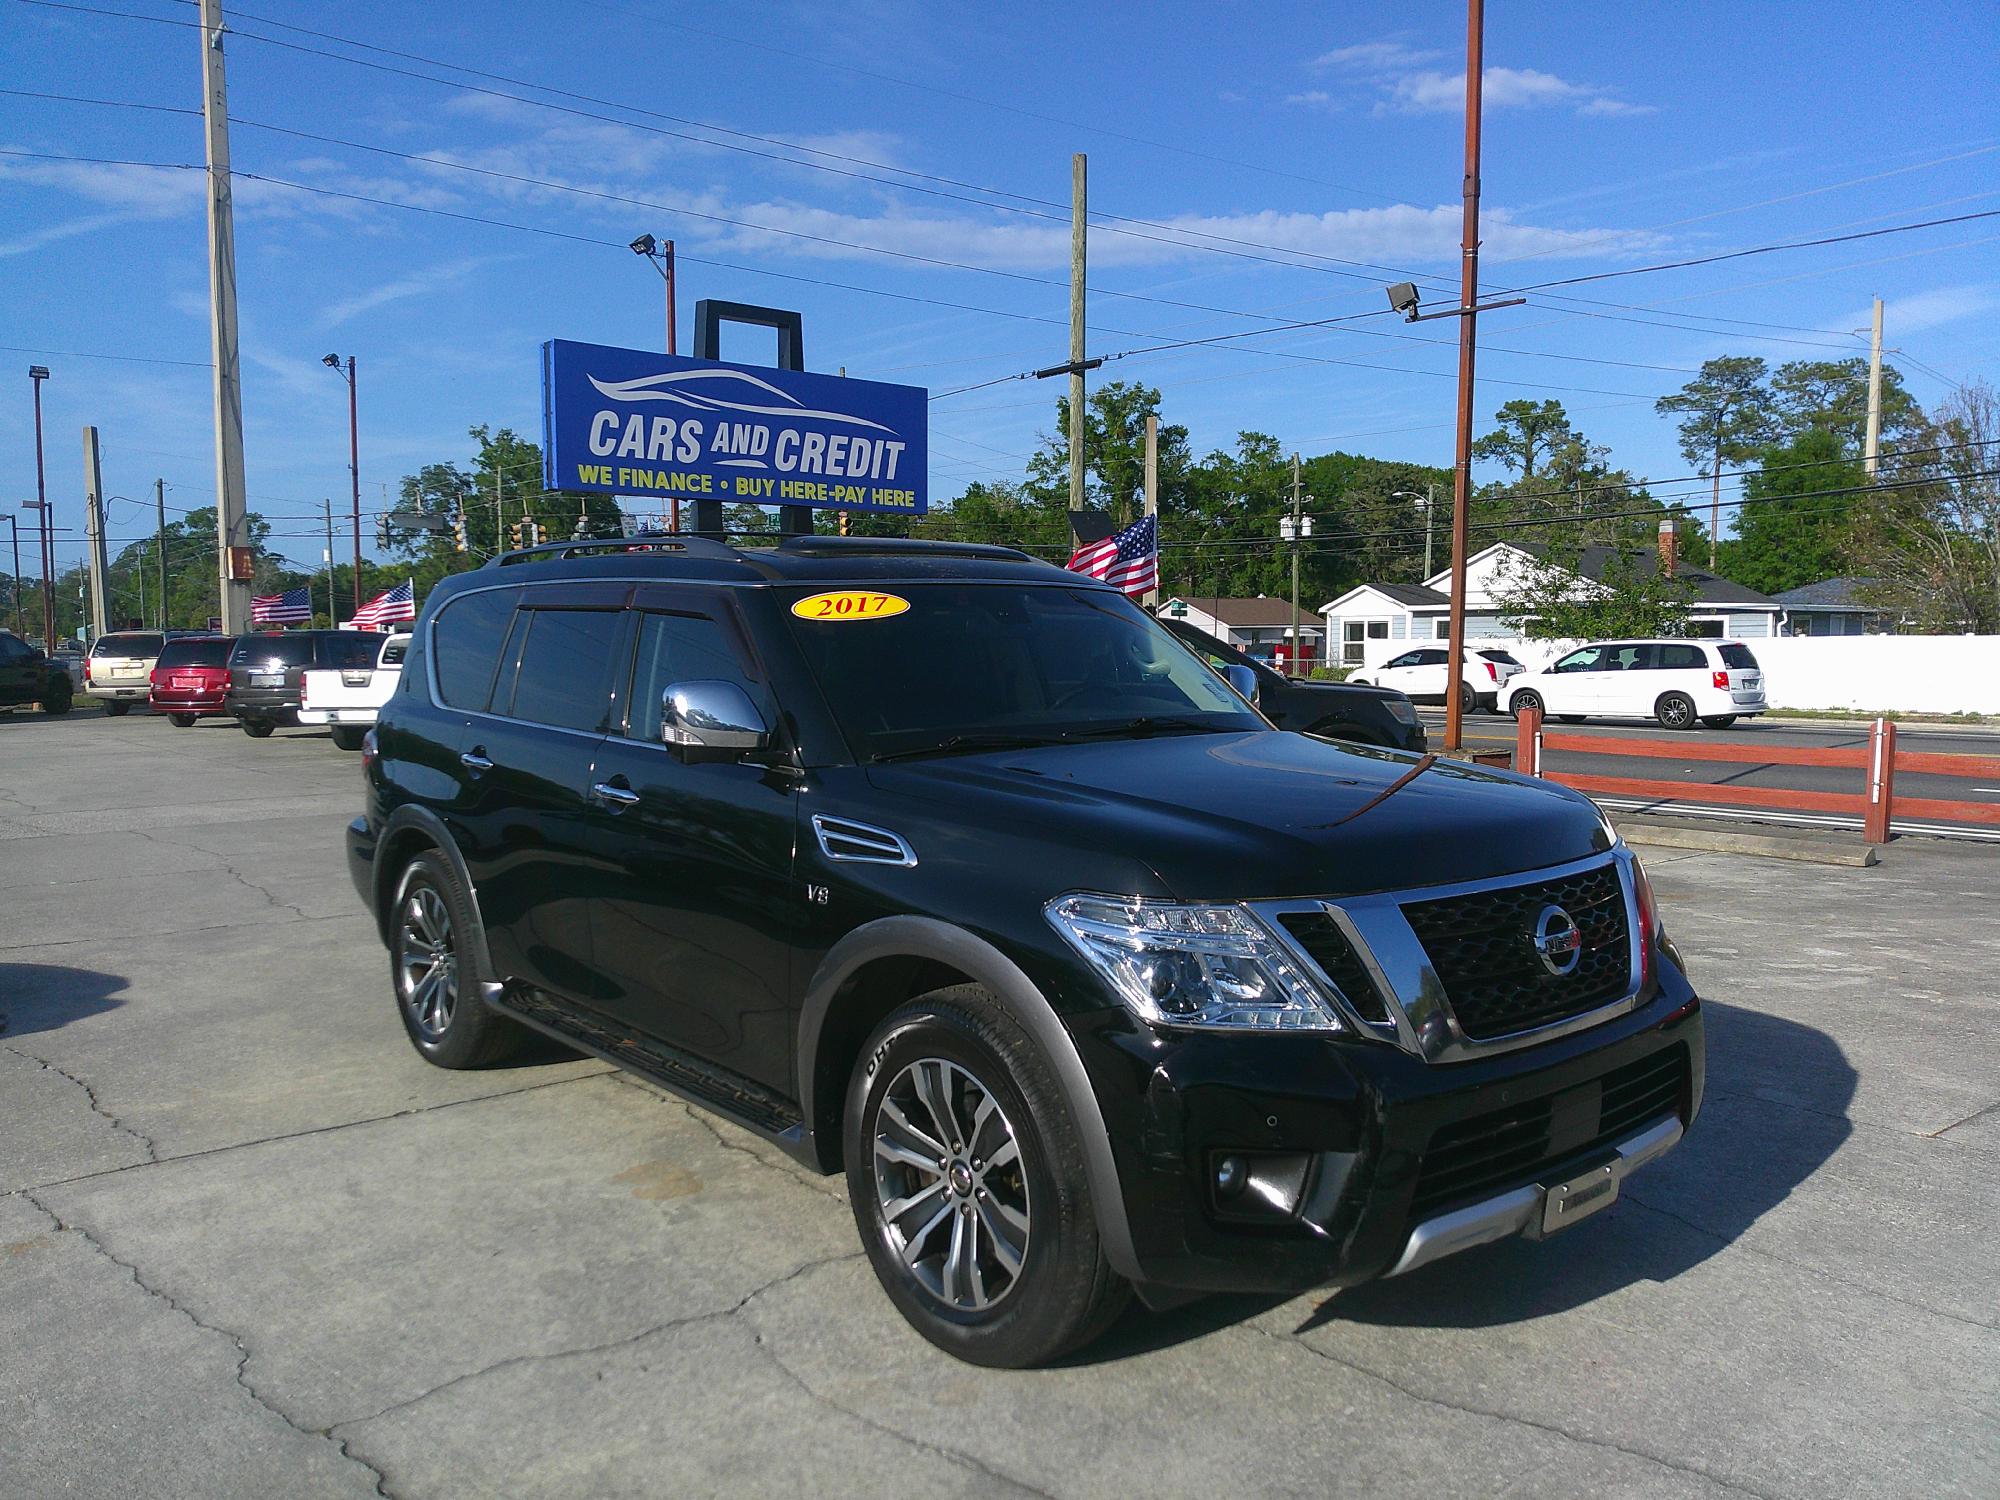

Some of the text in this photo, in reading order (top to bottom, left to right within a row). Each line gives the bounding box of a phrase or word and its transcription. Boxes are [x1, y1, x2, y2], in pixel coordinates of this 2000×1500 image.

[589, 410, 905, 480] CARS AND CREDIT
[578, 464, 612, 485] WE
[619, 467, 713, 493] FINANCE
[736, 477, 775, 497] BUY
[872, 488, 915, 507] HERE
[816, 597, 888, 616] 2017
[808, 884, 829, 905] V8
